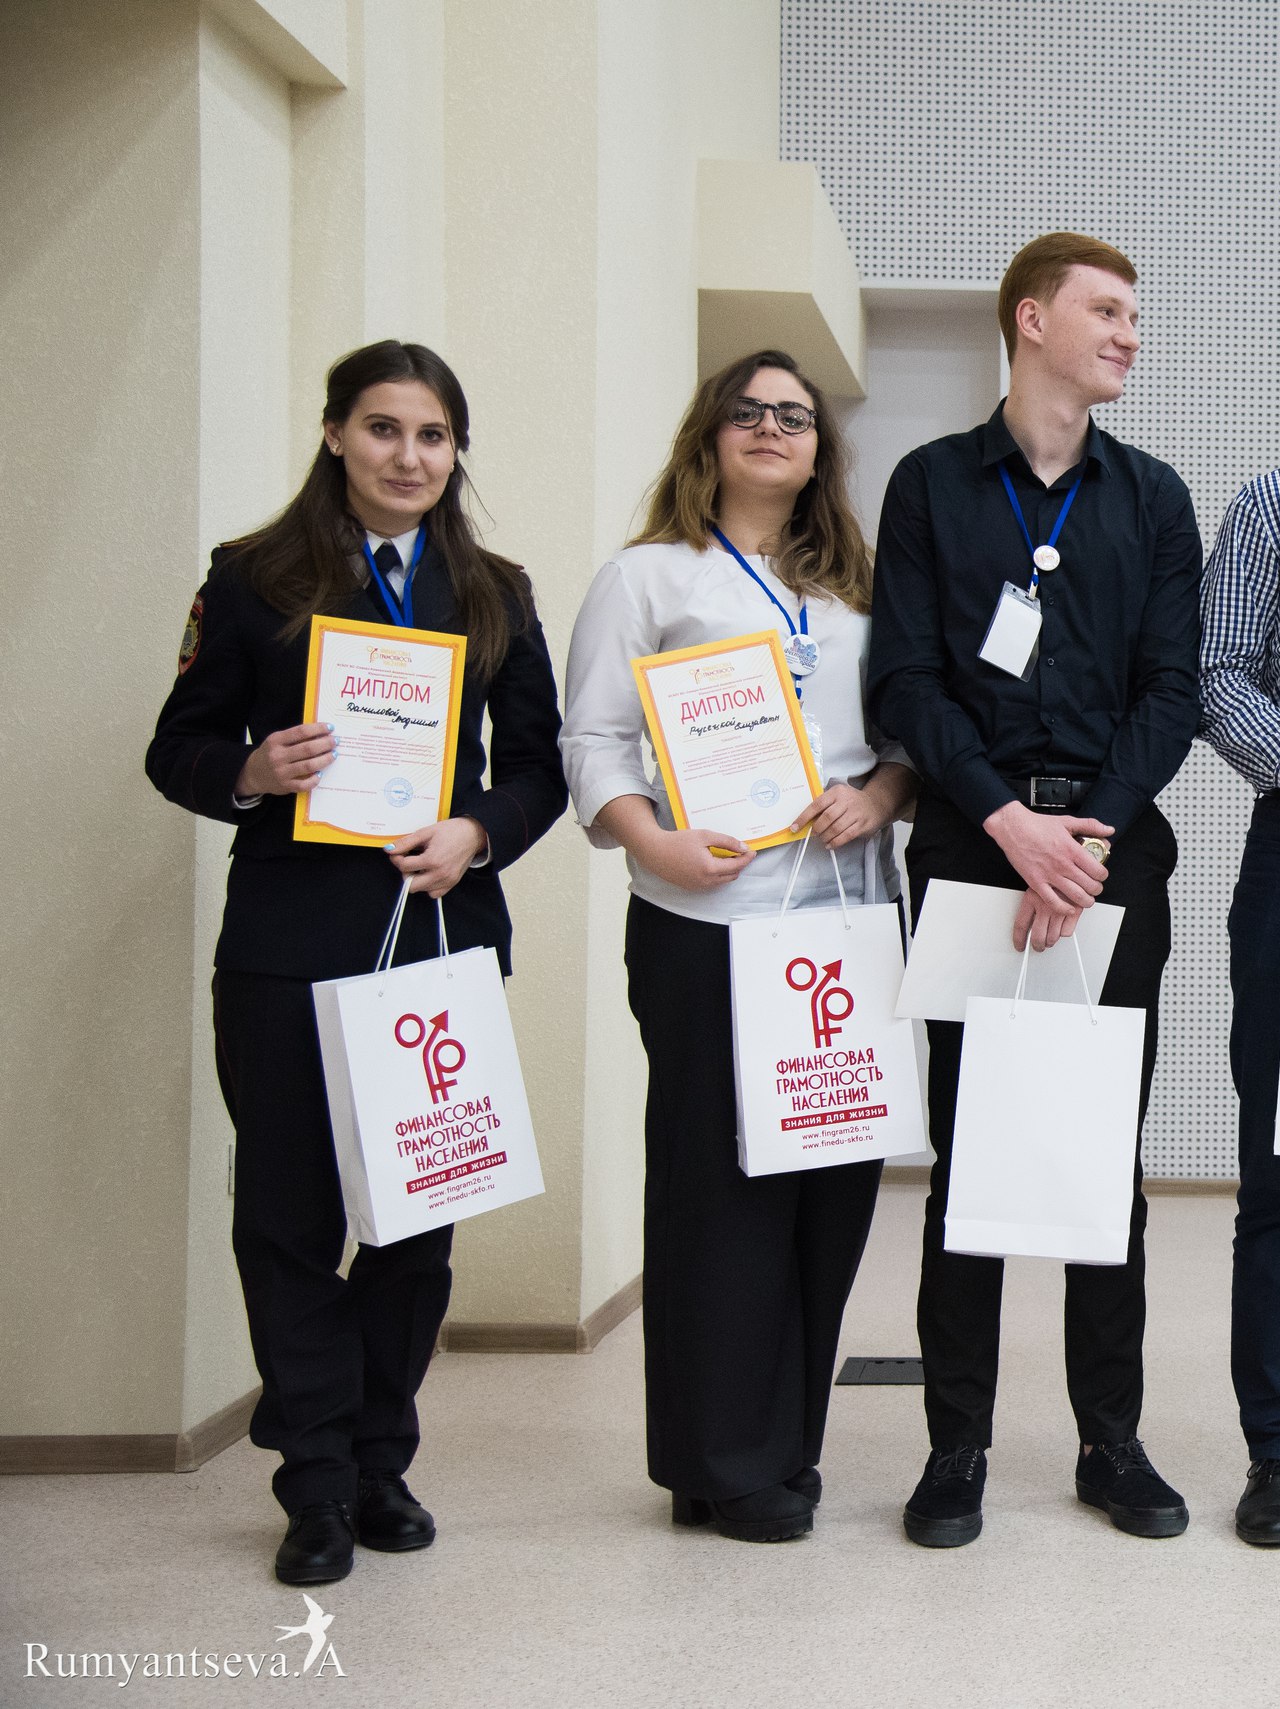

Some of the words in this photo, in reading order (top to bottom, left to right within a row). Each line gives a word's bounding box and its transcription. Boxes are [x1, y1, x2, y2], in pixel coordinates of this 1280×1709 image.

[341, 676, 431, 704] ДИПЛОМ
[681, 685, 765, 725] ДИПЛОМ
[776, 1048, 875, 1075] ФИНАНСОВАЯ
[776, 1066, 884, 1095] ГРАМОТНОСТЬ
[792, 1086, 870, 1112] НАСЕЛЕНИЯ
[395, 1095, 492, 1137] ФИНАНСОВАЯ
[785, 1117, 822, 1129] ЗНАНИЯ
[826, 1113, 845, 1124] ДЛЯ
[849, 1107, 884, 1119] ЖИЗНИ
[397, 1113, 501, 1158] ГРАМОТНОСТЬ
[802, 1125, 870, 1140] www.fingram26.ru
[802, 1134, 874, 1150] www.finedu-skfo.ru
[415, 1135, 489, 1173] НАСЕЛЕНИЯ
[410, 1172, 446, 1190] ЗНАНИЯ
[450, 1166, 468, 1179] ДЛЯ
[471, 1154, 504, 1171] ЖИЗНИ
[428, 1174, 492, 1199] www.fingram26.ru
[428, 1183, 495, 1210] www.finedu-skfo.ru
